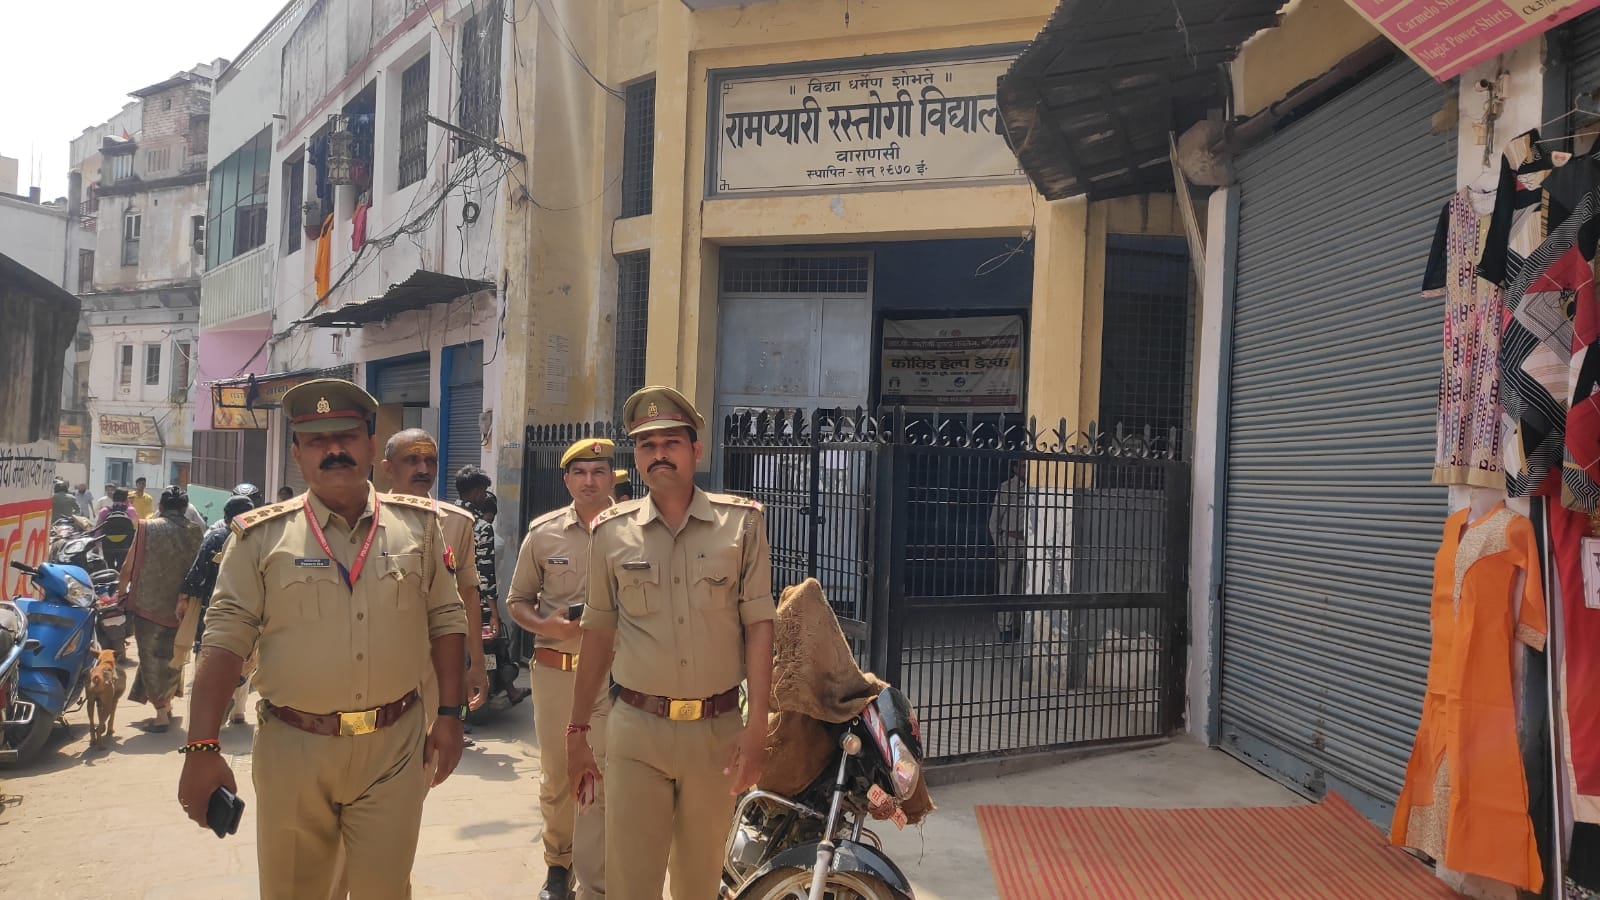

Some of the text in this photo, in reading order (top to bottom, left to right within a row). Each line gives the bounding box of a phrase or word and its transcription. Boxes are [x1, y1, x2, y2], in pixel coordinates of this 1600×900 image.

[1397, 6, 1440, 33] Carmelo
[1419, 8, 1513, 64] Magic Power Shirts
[807, 78, 841, 93] विद्या
[891, 69, 935, 89] शोभते
[726, 85, 1004, 149] रामप्यारी रस्तोगी विद्याल
[835, 141, 900, 162] वाराणसी
[855, 166, 876, 178] सन्
[891, 356, 936, 369] कोविड
[940, 356, 970, 370] हेल्प
